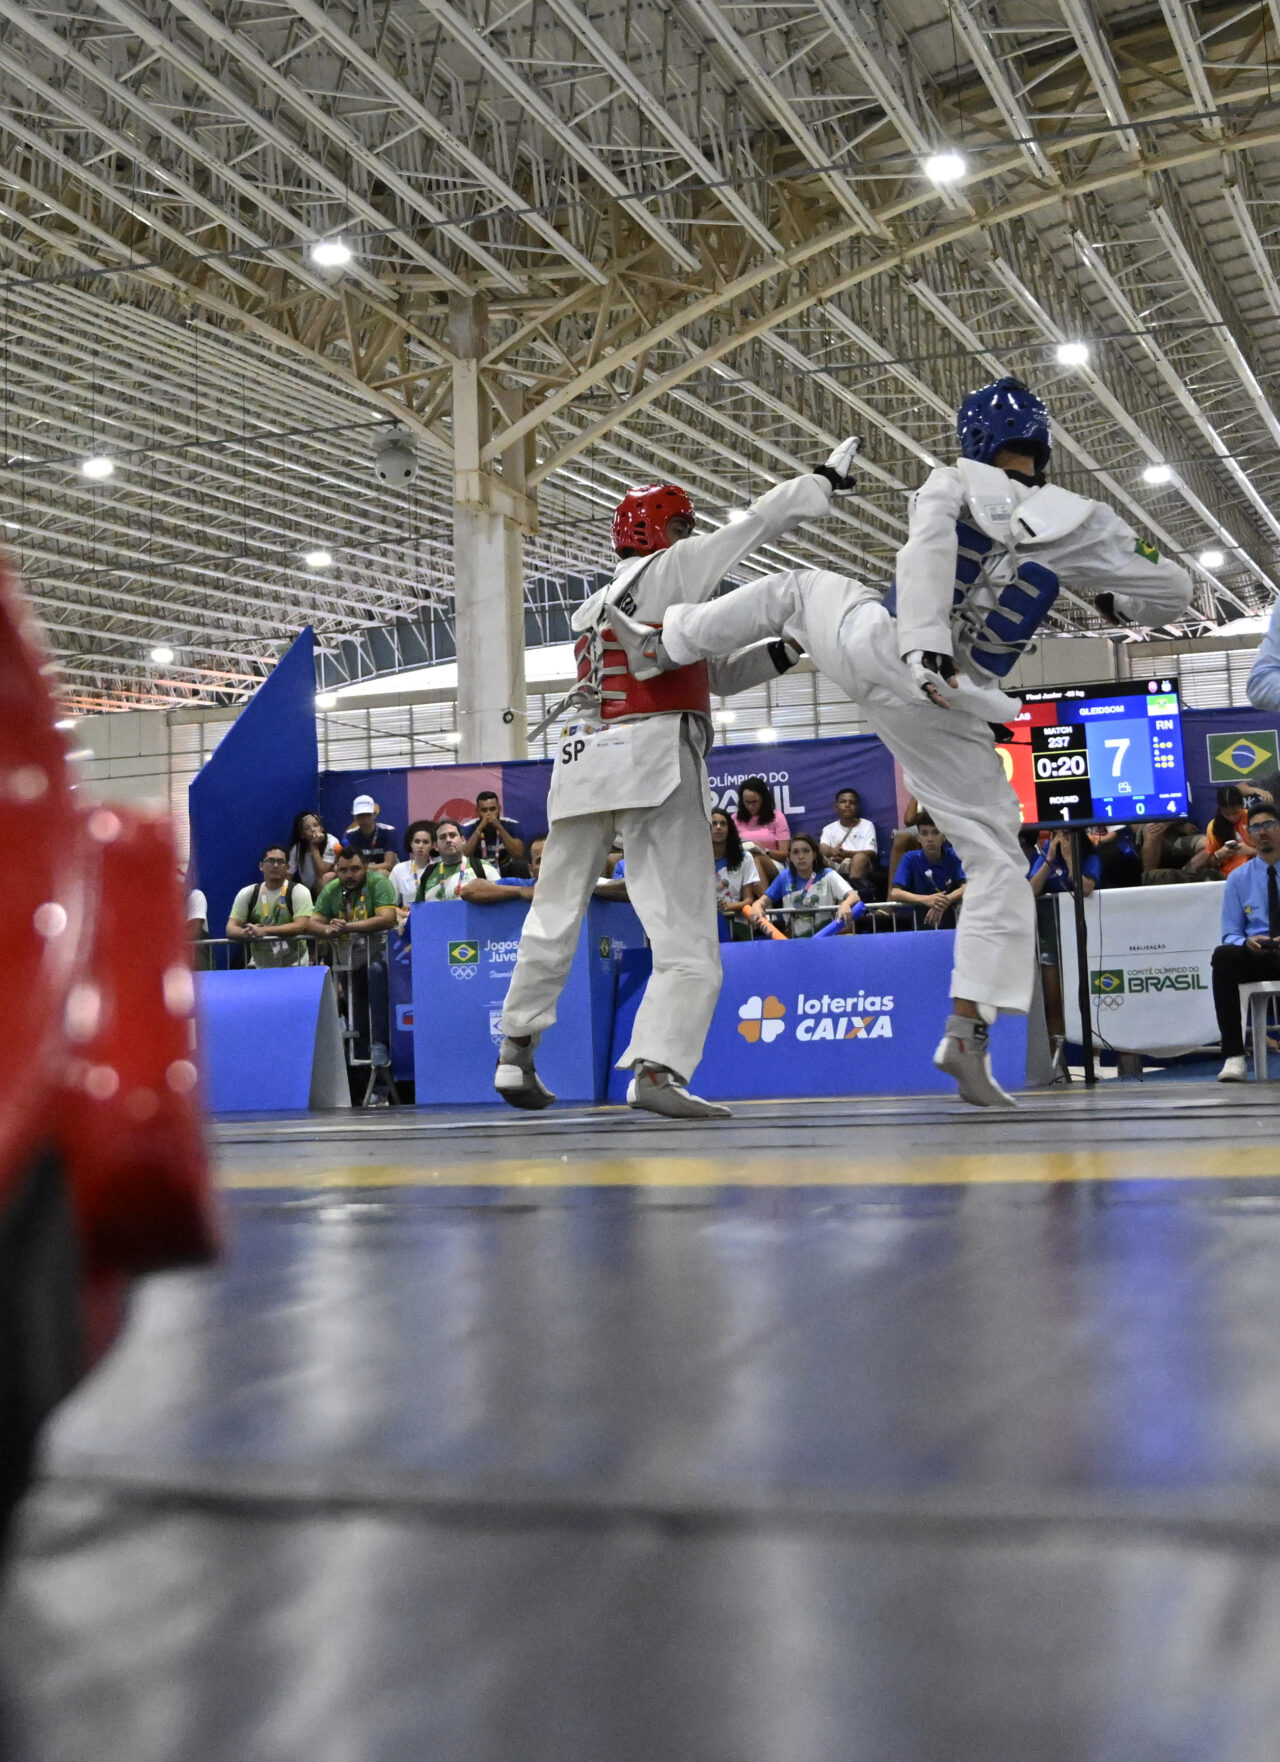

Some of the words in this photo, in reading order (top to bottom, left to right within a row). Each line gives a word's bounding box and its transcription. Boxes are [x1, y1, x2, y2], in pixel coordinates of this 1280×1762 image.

[1079, 705, 1124, 716] GLEIDSOM
[1043, 726, 1073, 735] MATCH
[1155, 719, 1174, 730] RN
[1048, 736, 1070, 748] 237
[562, 739, 585, 764] SP
[1104, 738, 1130, 777] 7
[1037, 756, 1085, 777] 0:20
[769, 771, 789, 783] DO
[1049, 795, 1079, 804] ROUND
[1105, 805, 1112, 817] 1
[1136, 803, 1145, 815] 0
[1166, 800, 1176, 812] 4
[1059, 806, 1069, 821] 1
[484, 940, 518, 952] Jogos
[1128, 974, 1208, 993] BRASIL
[797, 989, 894, 1015] loterias
[796, 1015, 893, 1041] CAIXA
